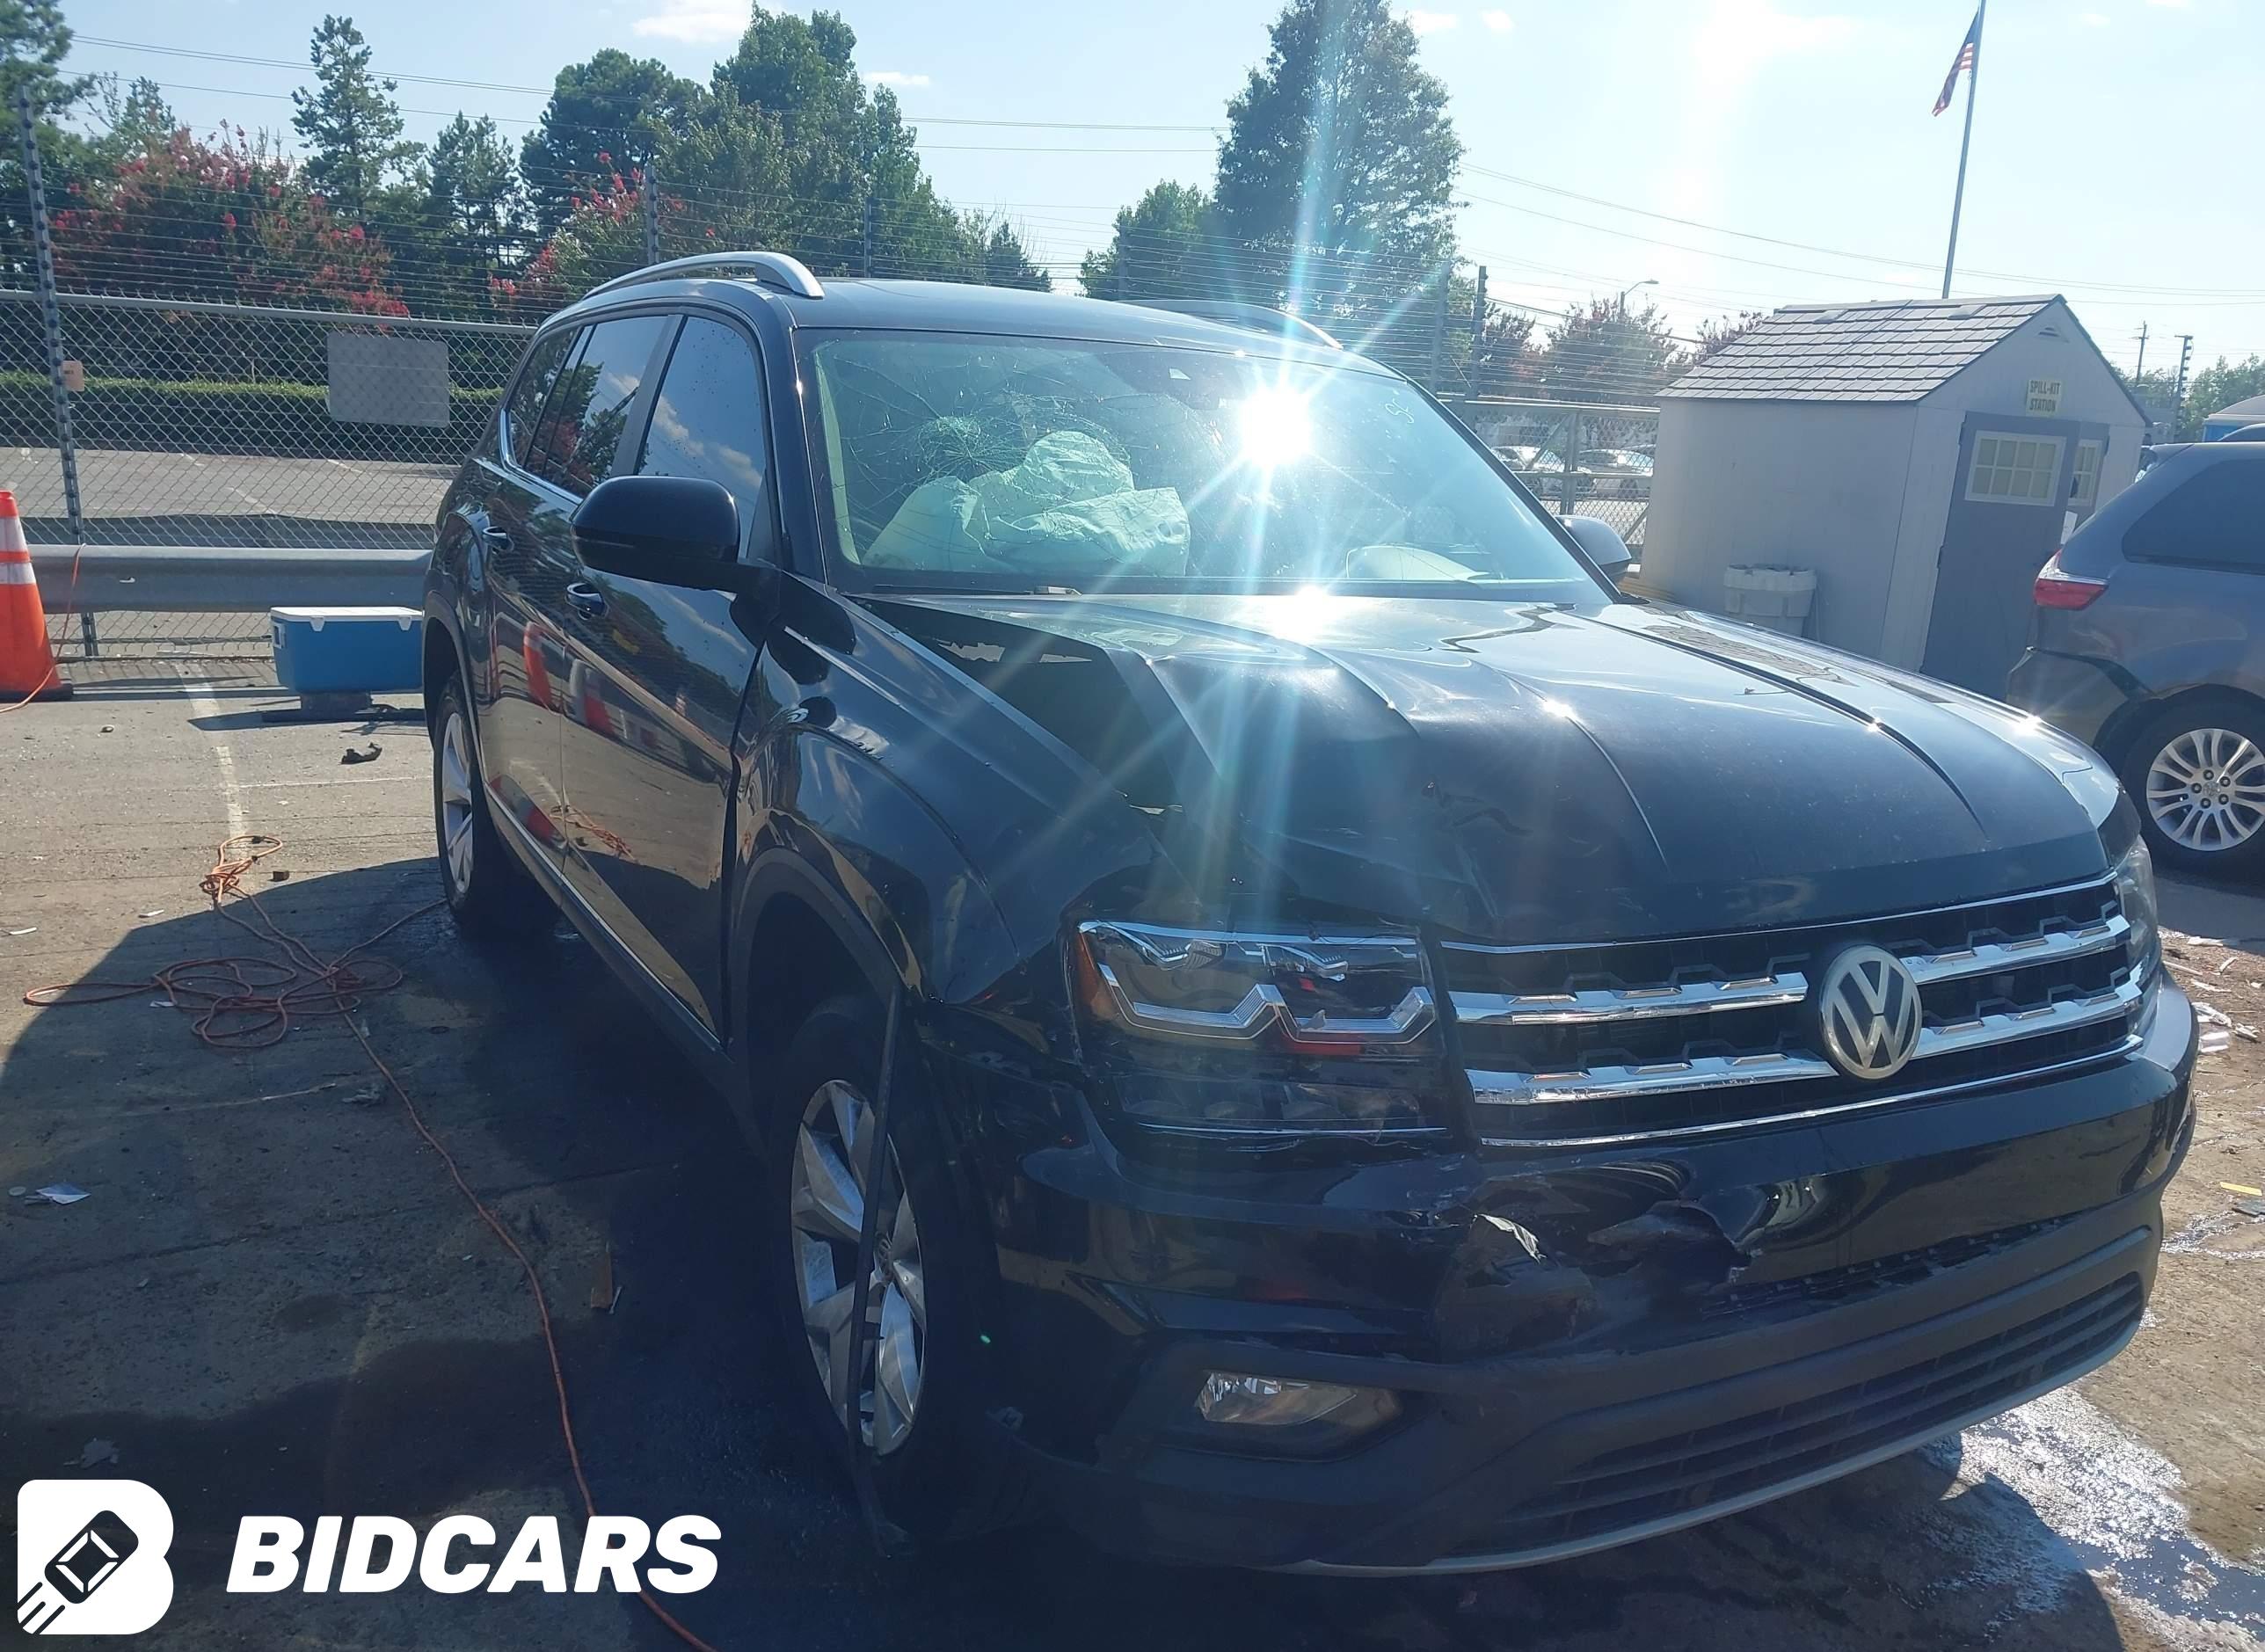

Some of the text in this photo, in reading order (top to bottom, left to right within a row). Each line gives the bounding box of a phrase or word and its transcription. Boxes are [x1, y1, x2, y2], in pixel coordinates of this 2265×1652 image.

[2029, 380, 2061, 395] SPILL-KIT
[2029, 397, 2056, 412] STATION
[1824, 950, 1920, 1074] VW
